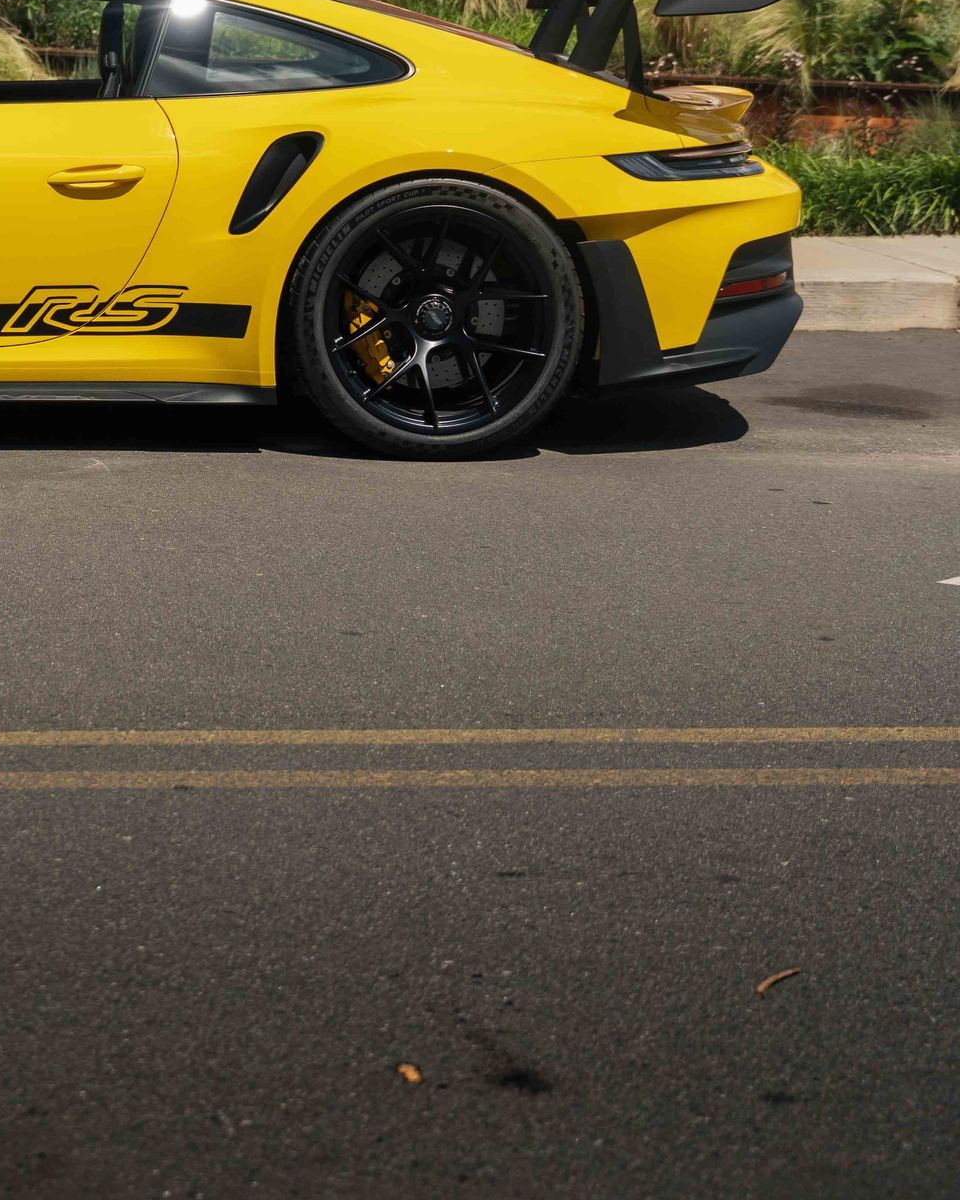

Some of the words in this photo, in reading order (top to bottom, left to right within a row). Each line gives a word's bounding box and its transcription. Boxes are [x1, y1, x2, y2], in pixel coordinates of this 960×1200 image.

[309, 224, 351, 294] MICHELIN
[354, 206, 377, 224] PILOT
[376, 194, 403, 208] SPORT
[0, 285, 190, 333] RS
